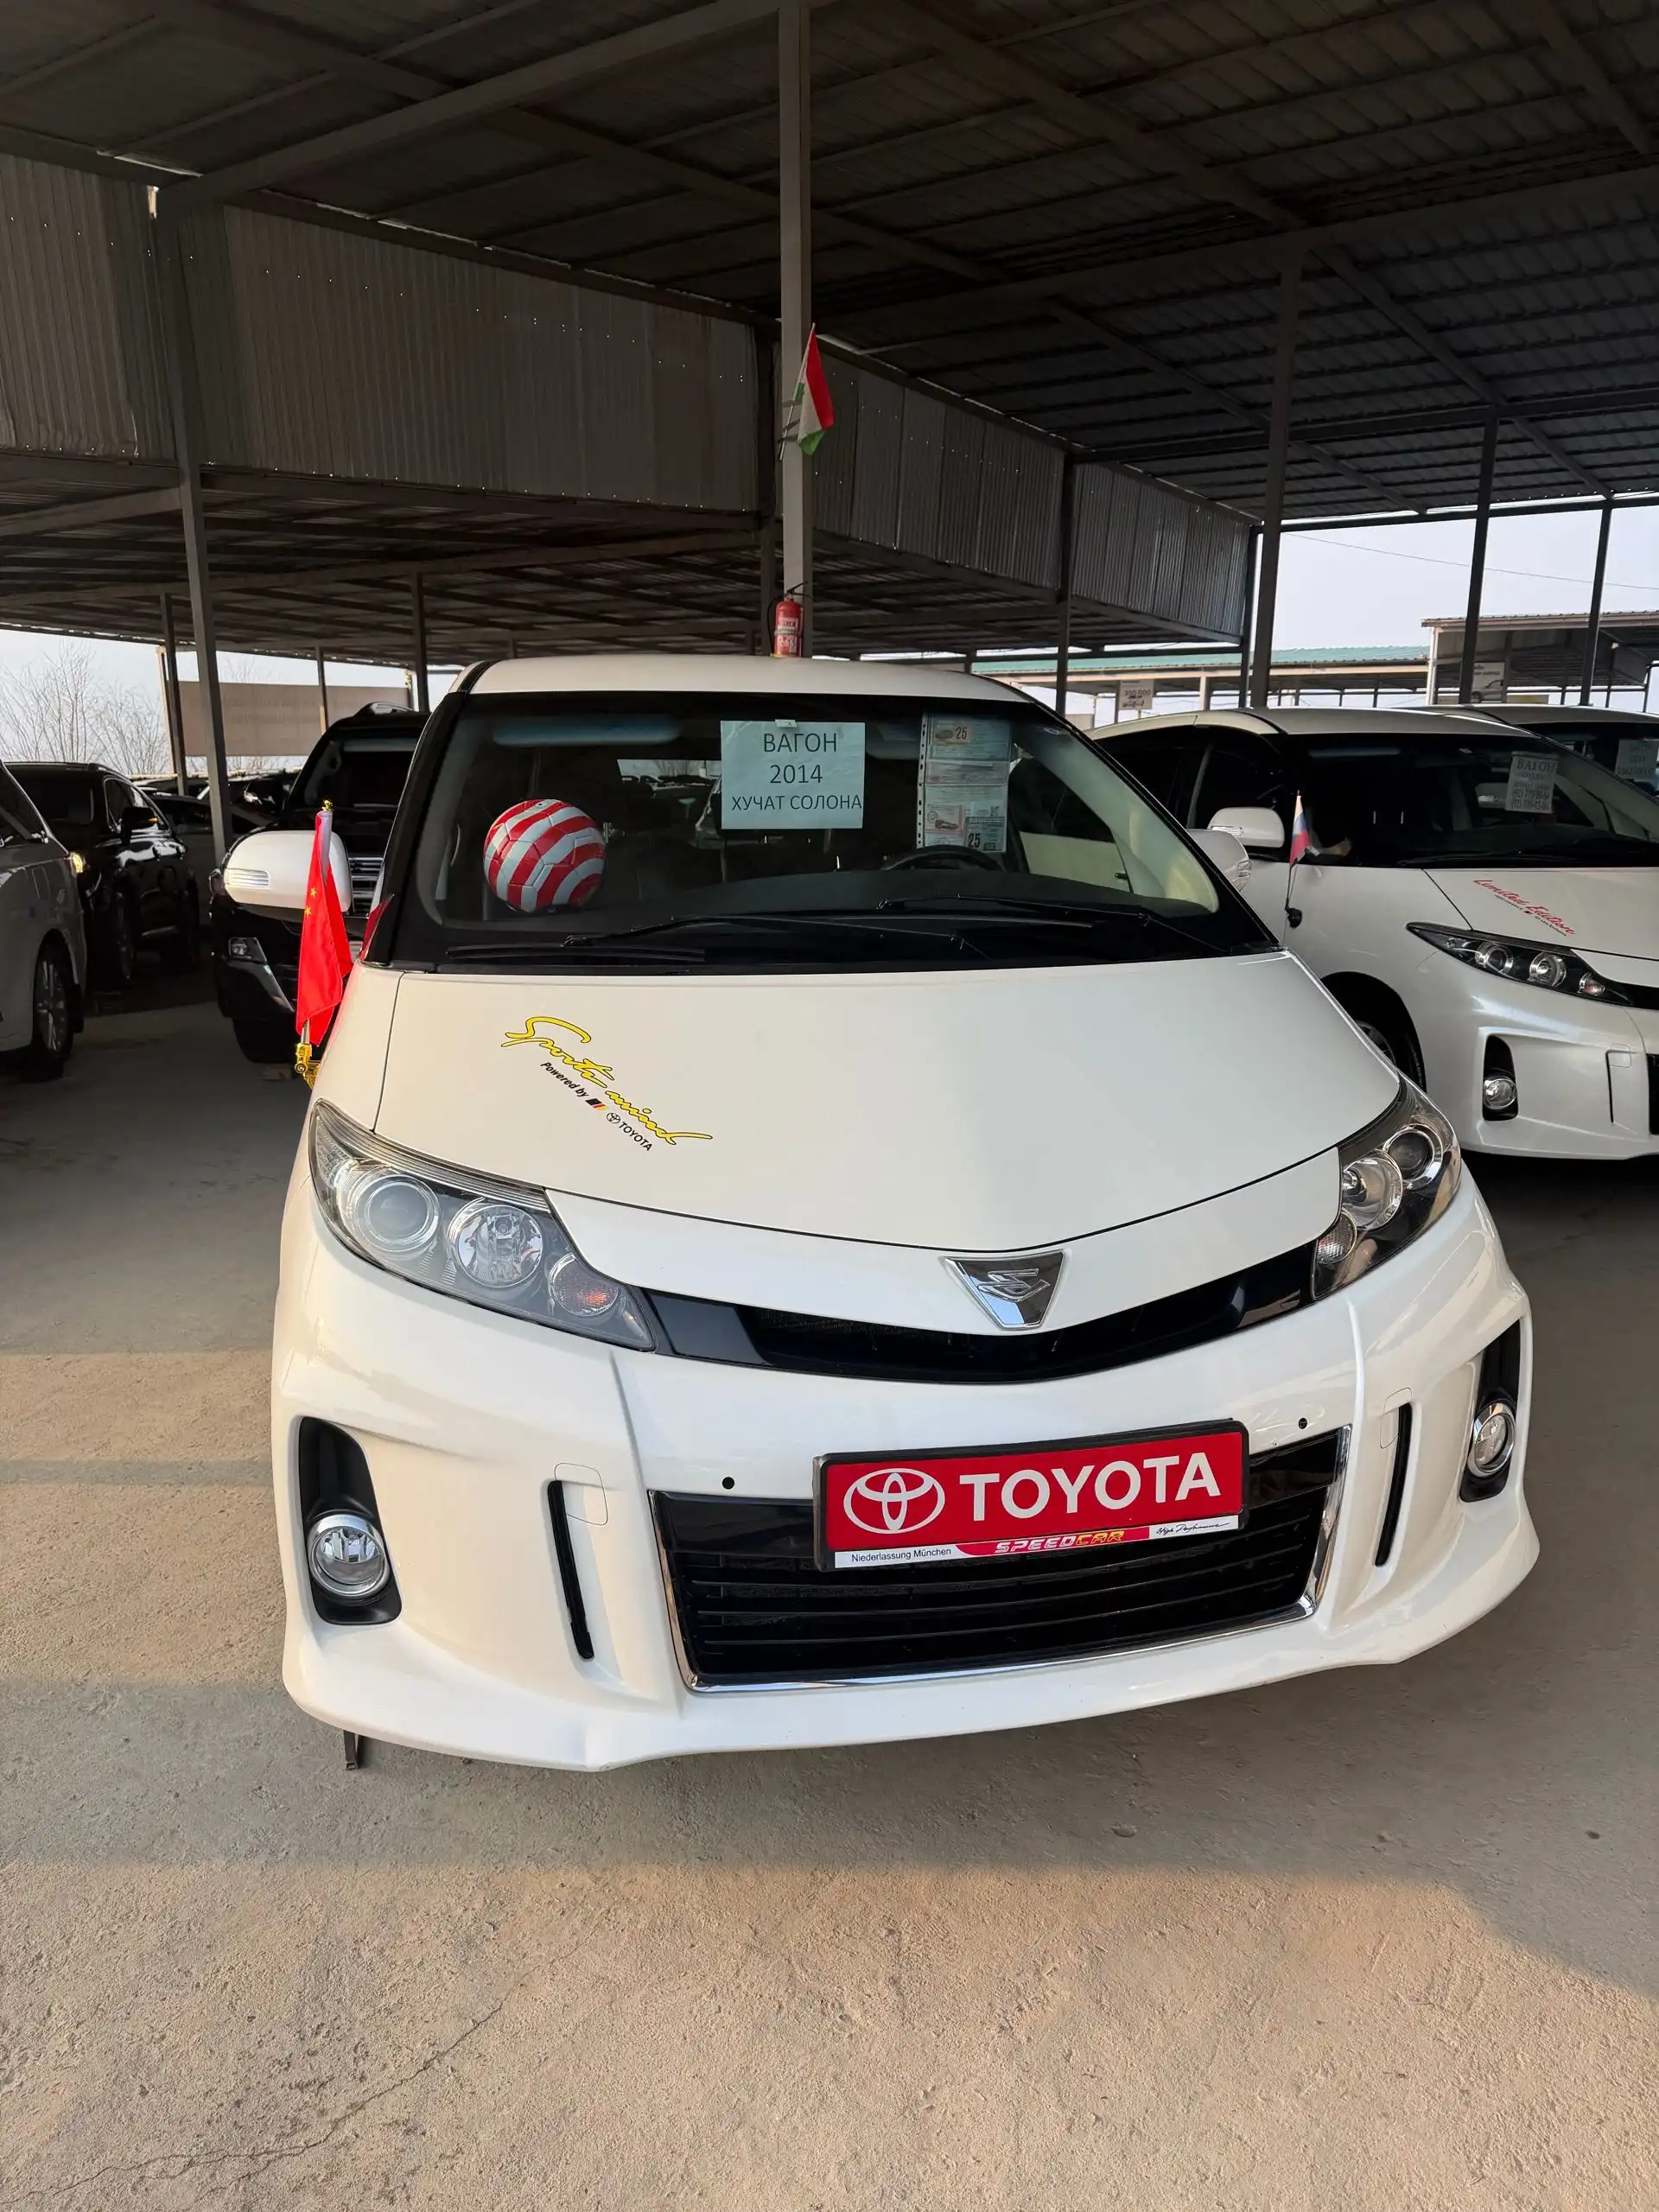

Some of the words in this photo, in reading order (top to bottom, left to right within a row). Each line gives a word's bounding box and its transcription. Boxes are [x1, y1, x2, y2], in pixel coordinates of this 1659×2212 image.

[763, 732, 838, 753] ВАГОН
[956, 727, 968, 740] 25
[769, 764, 823, 785] 2014
[732, 795, 785, 810] ХУЧАТ
[790, 794, 862, 810] СОЛОНА
[968, 833, 981, 849] 25
[1473, 880, 1530, 906] Limited
[1526, 906, 1576, 935] Edition
[540, 1061, 581, 1090] Powered
[575, 1084, 589, 1097] by
[619, 1121, 653, 1152] TOYOTA
[959, 1452, 1222, 1522] TOYOTA
[851, 1552, 912, 1562] Niederlassung
[913, 1548, 951, 1558] München
